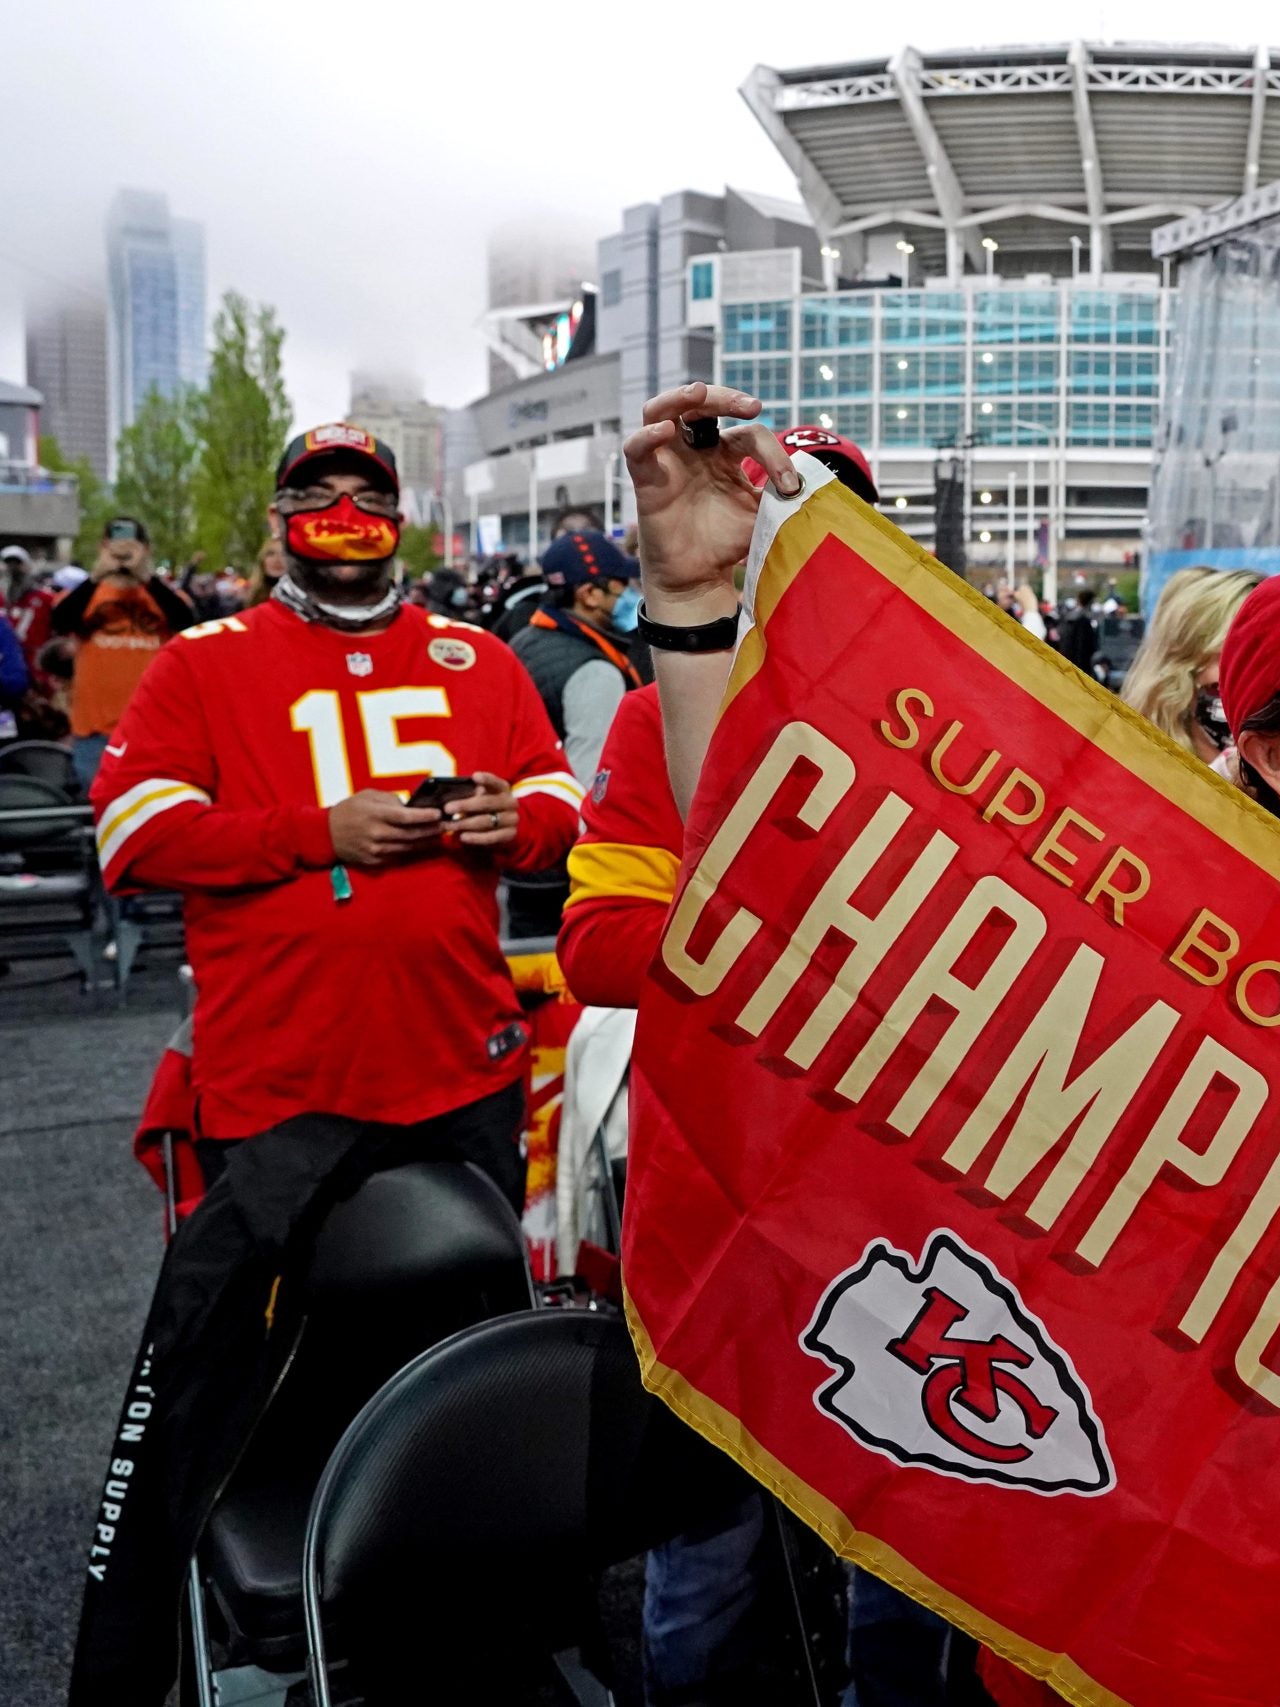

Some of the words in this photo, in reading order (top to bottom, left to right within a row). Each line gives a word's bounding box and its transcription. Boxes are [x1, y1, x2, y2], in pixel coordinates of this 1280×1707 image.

[289, 686, 456, 808] 15
[880, 688, 1151, 926] SUPER
[885, 1285, 1060, 1465] KC
[88, 1458, 135, 1581] SUPPLY
